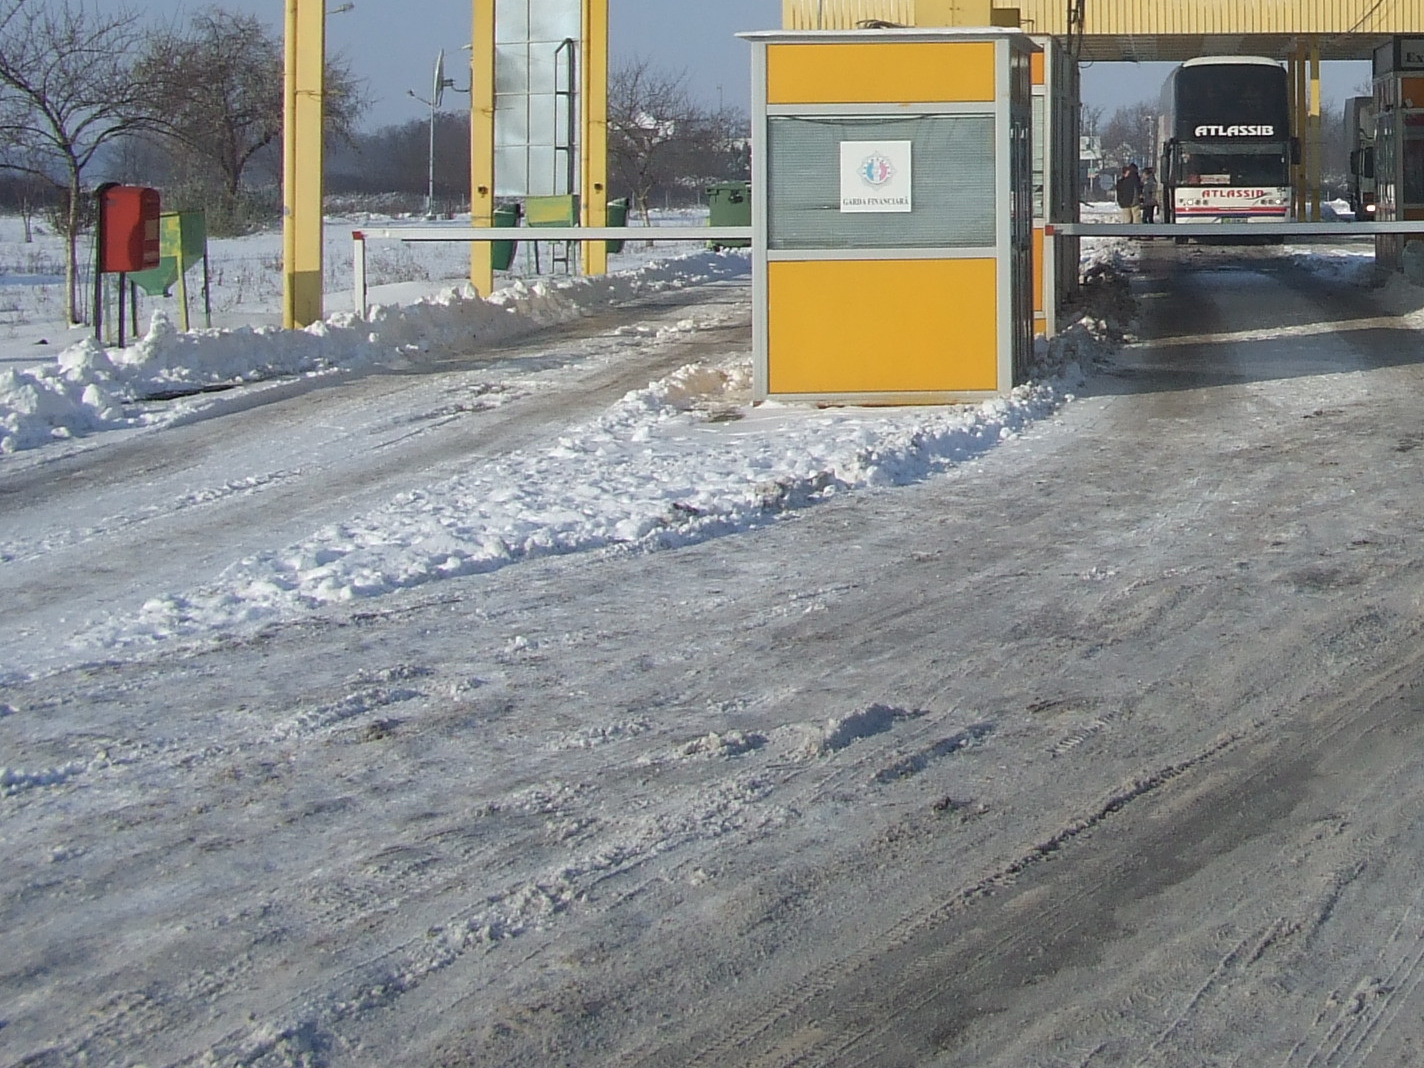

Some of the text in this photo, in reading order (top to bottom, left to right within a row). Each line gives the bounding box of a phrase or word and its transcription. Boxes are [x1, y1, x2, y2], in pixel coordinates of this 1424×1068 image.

[1194, 125, 1275, 137] ATLASSIB
[1201, 189, 1265, 199] ATLASSIB
[843, 195, 909, 206] GARDA FINANCIARĂ
